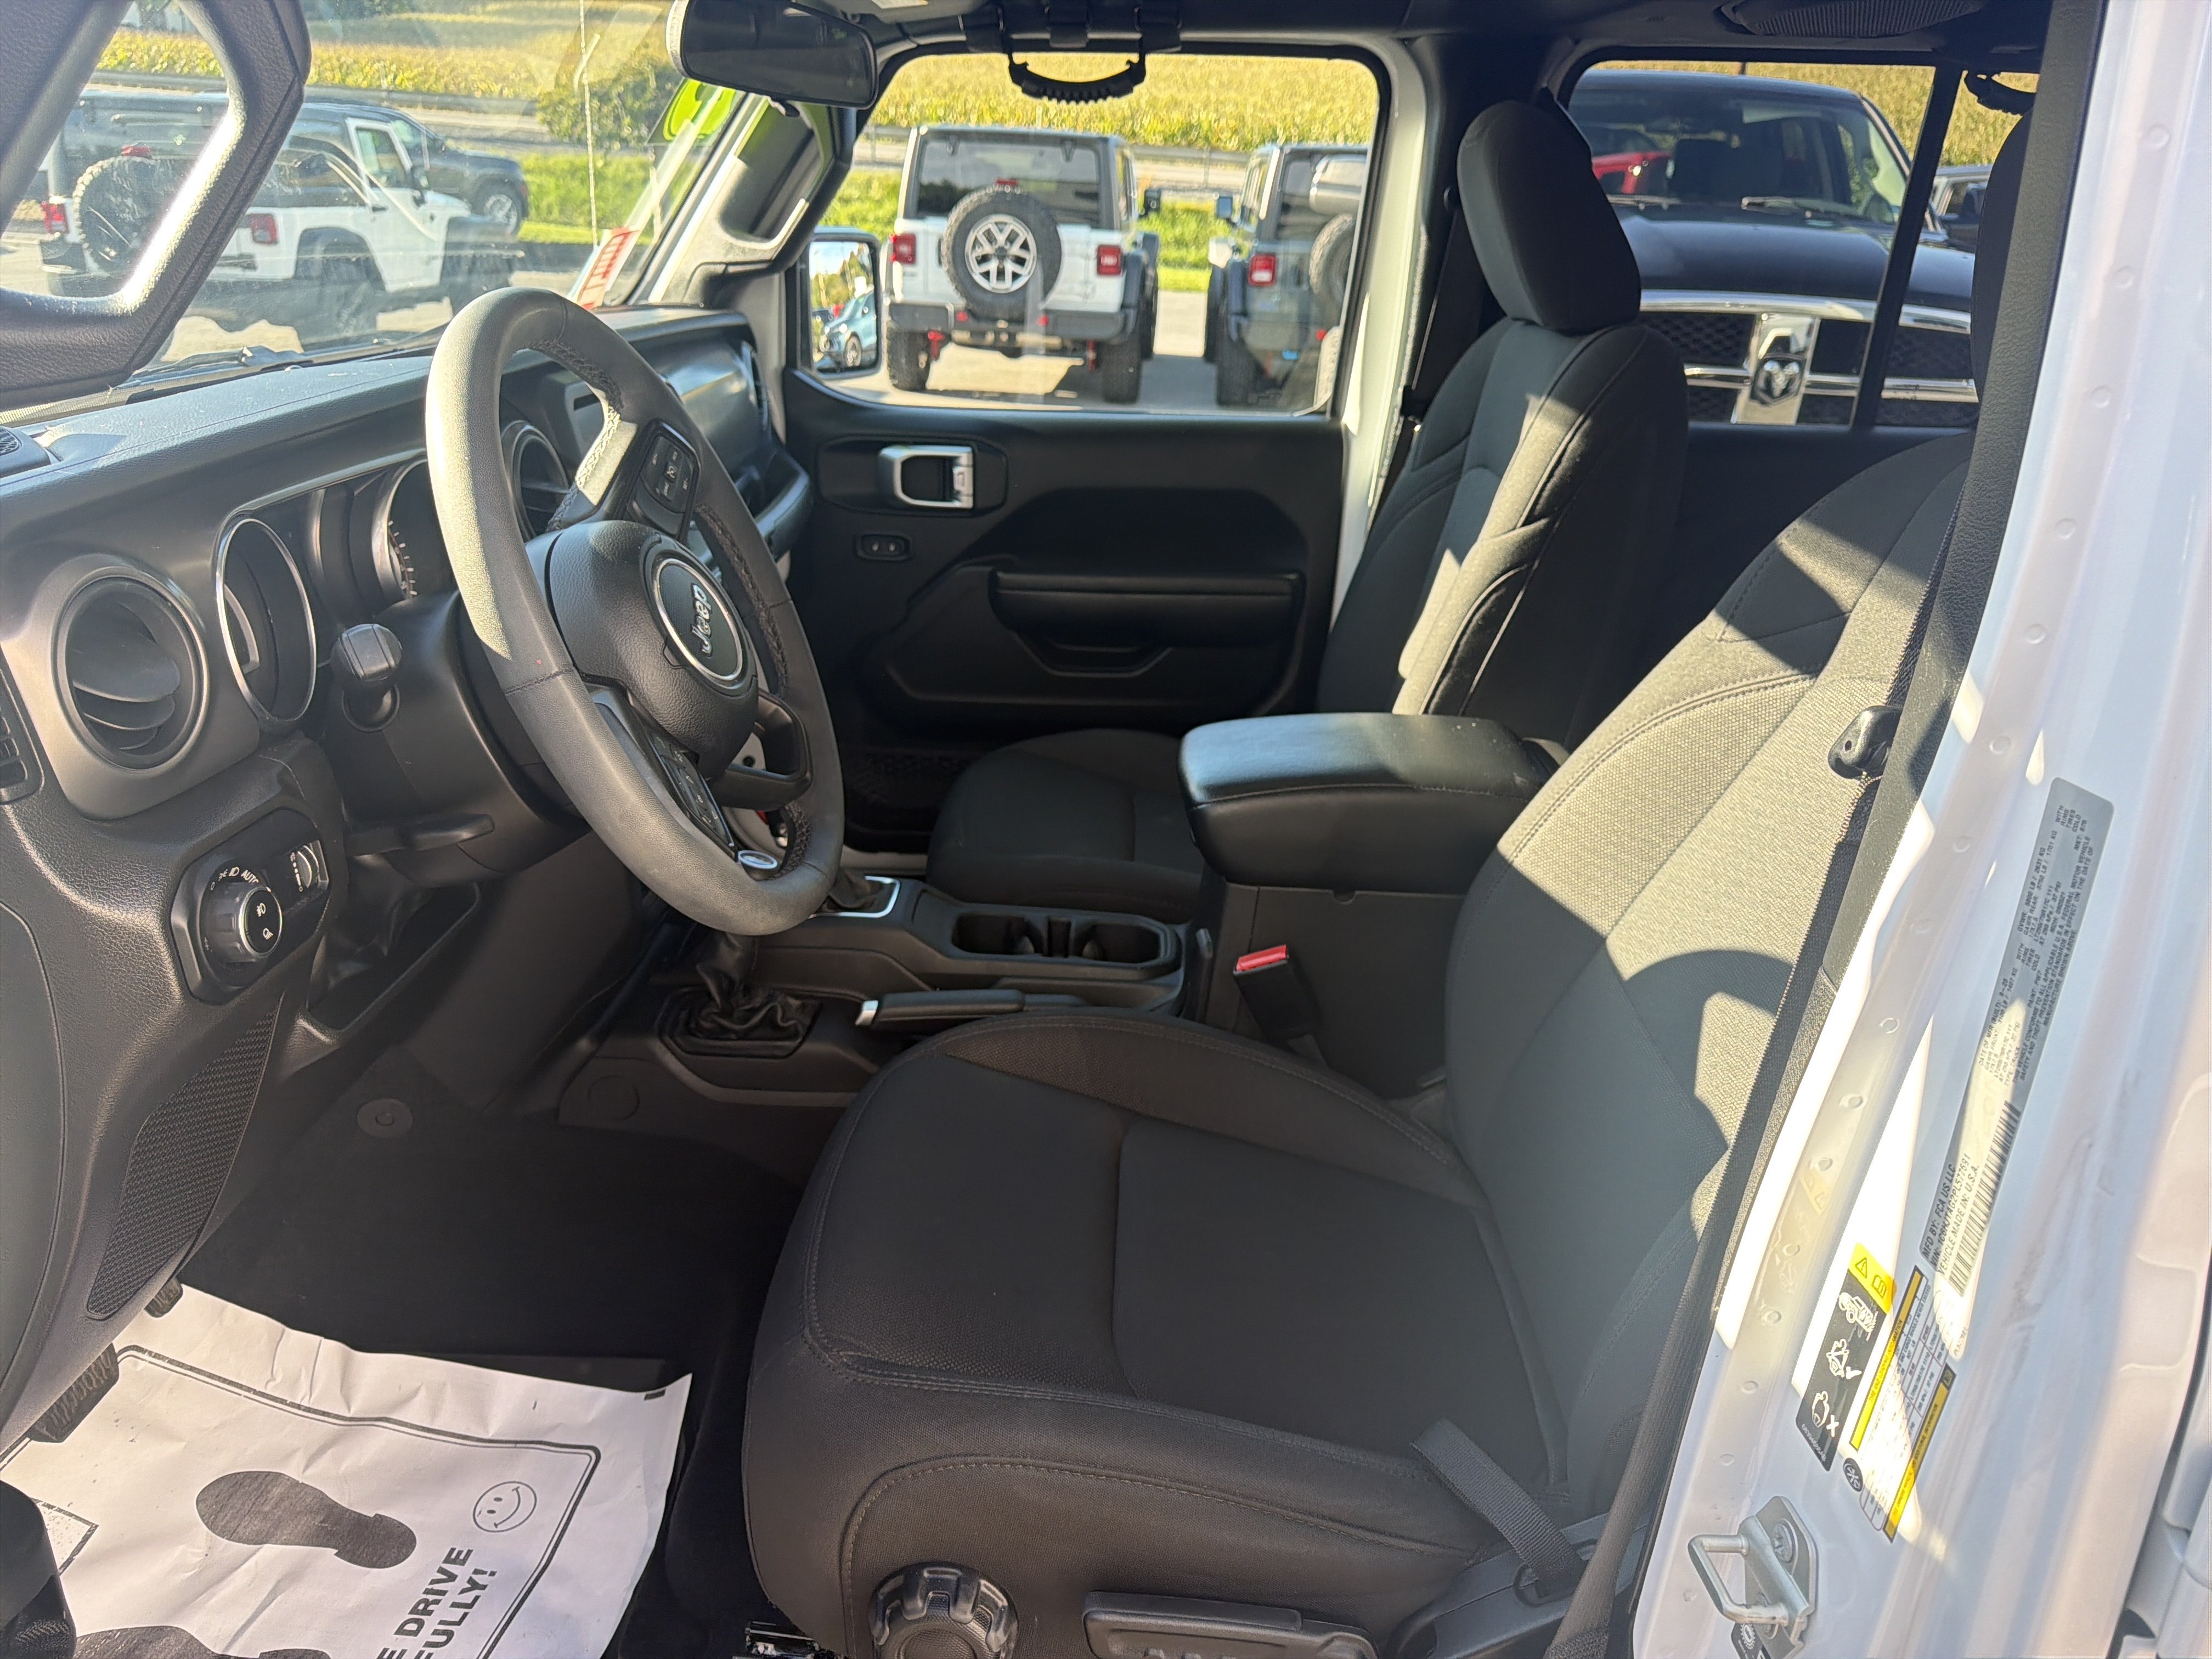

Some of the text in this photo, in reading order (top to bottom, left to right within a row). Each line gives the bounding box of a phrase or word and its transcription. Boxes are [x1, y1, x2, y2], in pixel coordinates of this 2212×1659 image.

[692, 584, 712, 655] Jeep
[2059, 809, 2069, 826] RIMS
[2066, 809, 2076, 828] TIRES
[2077, 837, 2091, 864] VEHICLE
[2087, 847, 2095, 856] OF
[2023, 915, 2033, 935] GAWR
[2045, 841, 2053, 855] 1701
[2050, 830, 2057, 839] KG
[2054, 805, 2064, 822] WITH
[2029, 881, 2036, 889] LB
[2038, 847, 2046, 856] KG
[2070, 865, 2082, 889] MOTOR
[2081, 857, 2091, 875] DATE
[2038, 936, 2045, 945] AT
[2053, 881, 2062, 892] PSI
[2071, 814, 2081, 832] COLD
[2076, 877, 2085, 890] THE
[2061, 890, 2075, 921] FEDERAL
[2073, 892, 2081, 901] ON
[2066, 903, 2078, 928] EFFECT
[2021, 947, 2029, 963] RIMS
[2025, 948, 2035, 967] TIRES
[2042, 944, 2058, 983] APPLICABLE
[2051, 938, 2067, 978] STANDARDS
[2035, 996, 2042, 1006] TO
[2038, 983, 2046, 996] ALL
[2038, 979, 2055, 1019] PREVENTION
[2042, 978, 2062, 1026] MANUFACTURE
[2057, 952, 2070, 977] SHOWN
[1984, 1051, 1993, 1070] GAWR
[2001, 1000, 2008, 1008] LB
[2011, 967, 2018, 977] KG
[2016, 943, 2024, 960] WITH
[1998, 1073, 2004, 1081] AT
[2031, 953, 2040, 970] COLD
[2024, 1007, 2039, 1042] CONFORMS
[2032, 1020, 2041, 1040] THEFT
[1978, 1049, 1987, 1065] DATE
[1983, 1040, 1989, 1048] OF
[2010, 1046, 2020, 1066] TRUCK
[2017, 1042, 2028, 1068] VEHICLE
[2027, 1041, 2035, 1056] AND
[2012, 1069, 2020, 1084] THIS
[2019, 1057, 2030, 1080] SAFETY
[1922, 1164, 1956, 1258] MFD BY: FCA US LLC
[1938, 1162, 1979, 1276] VEHICLE MADE IN: U.S.A.
[1930, 1246, 1942, 1267] VIN:
[393, 1547, 473, 1637] DRIVE
